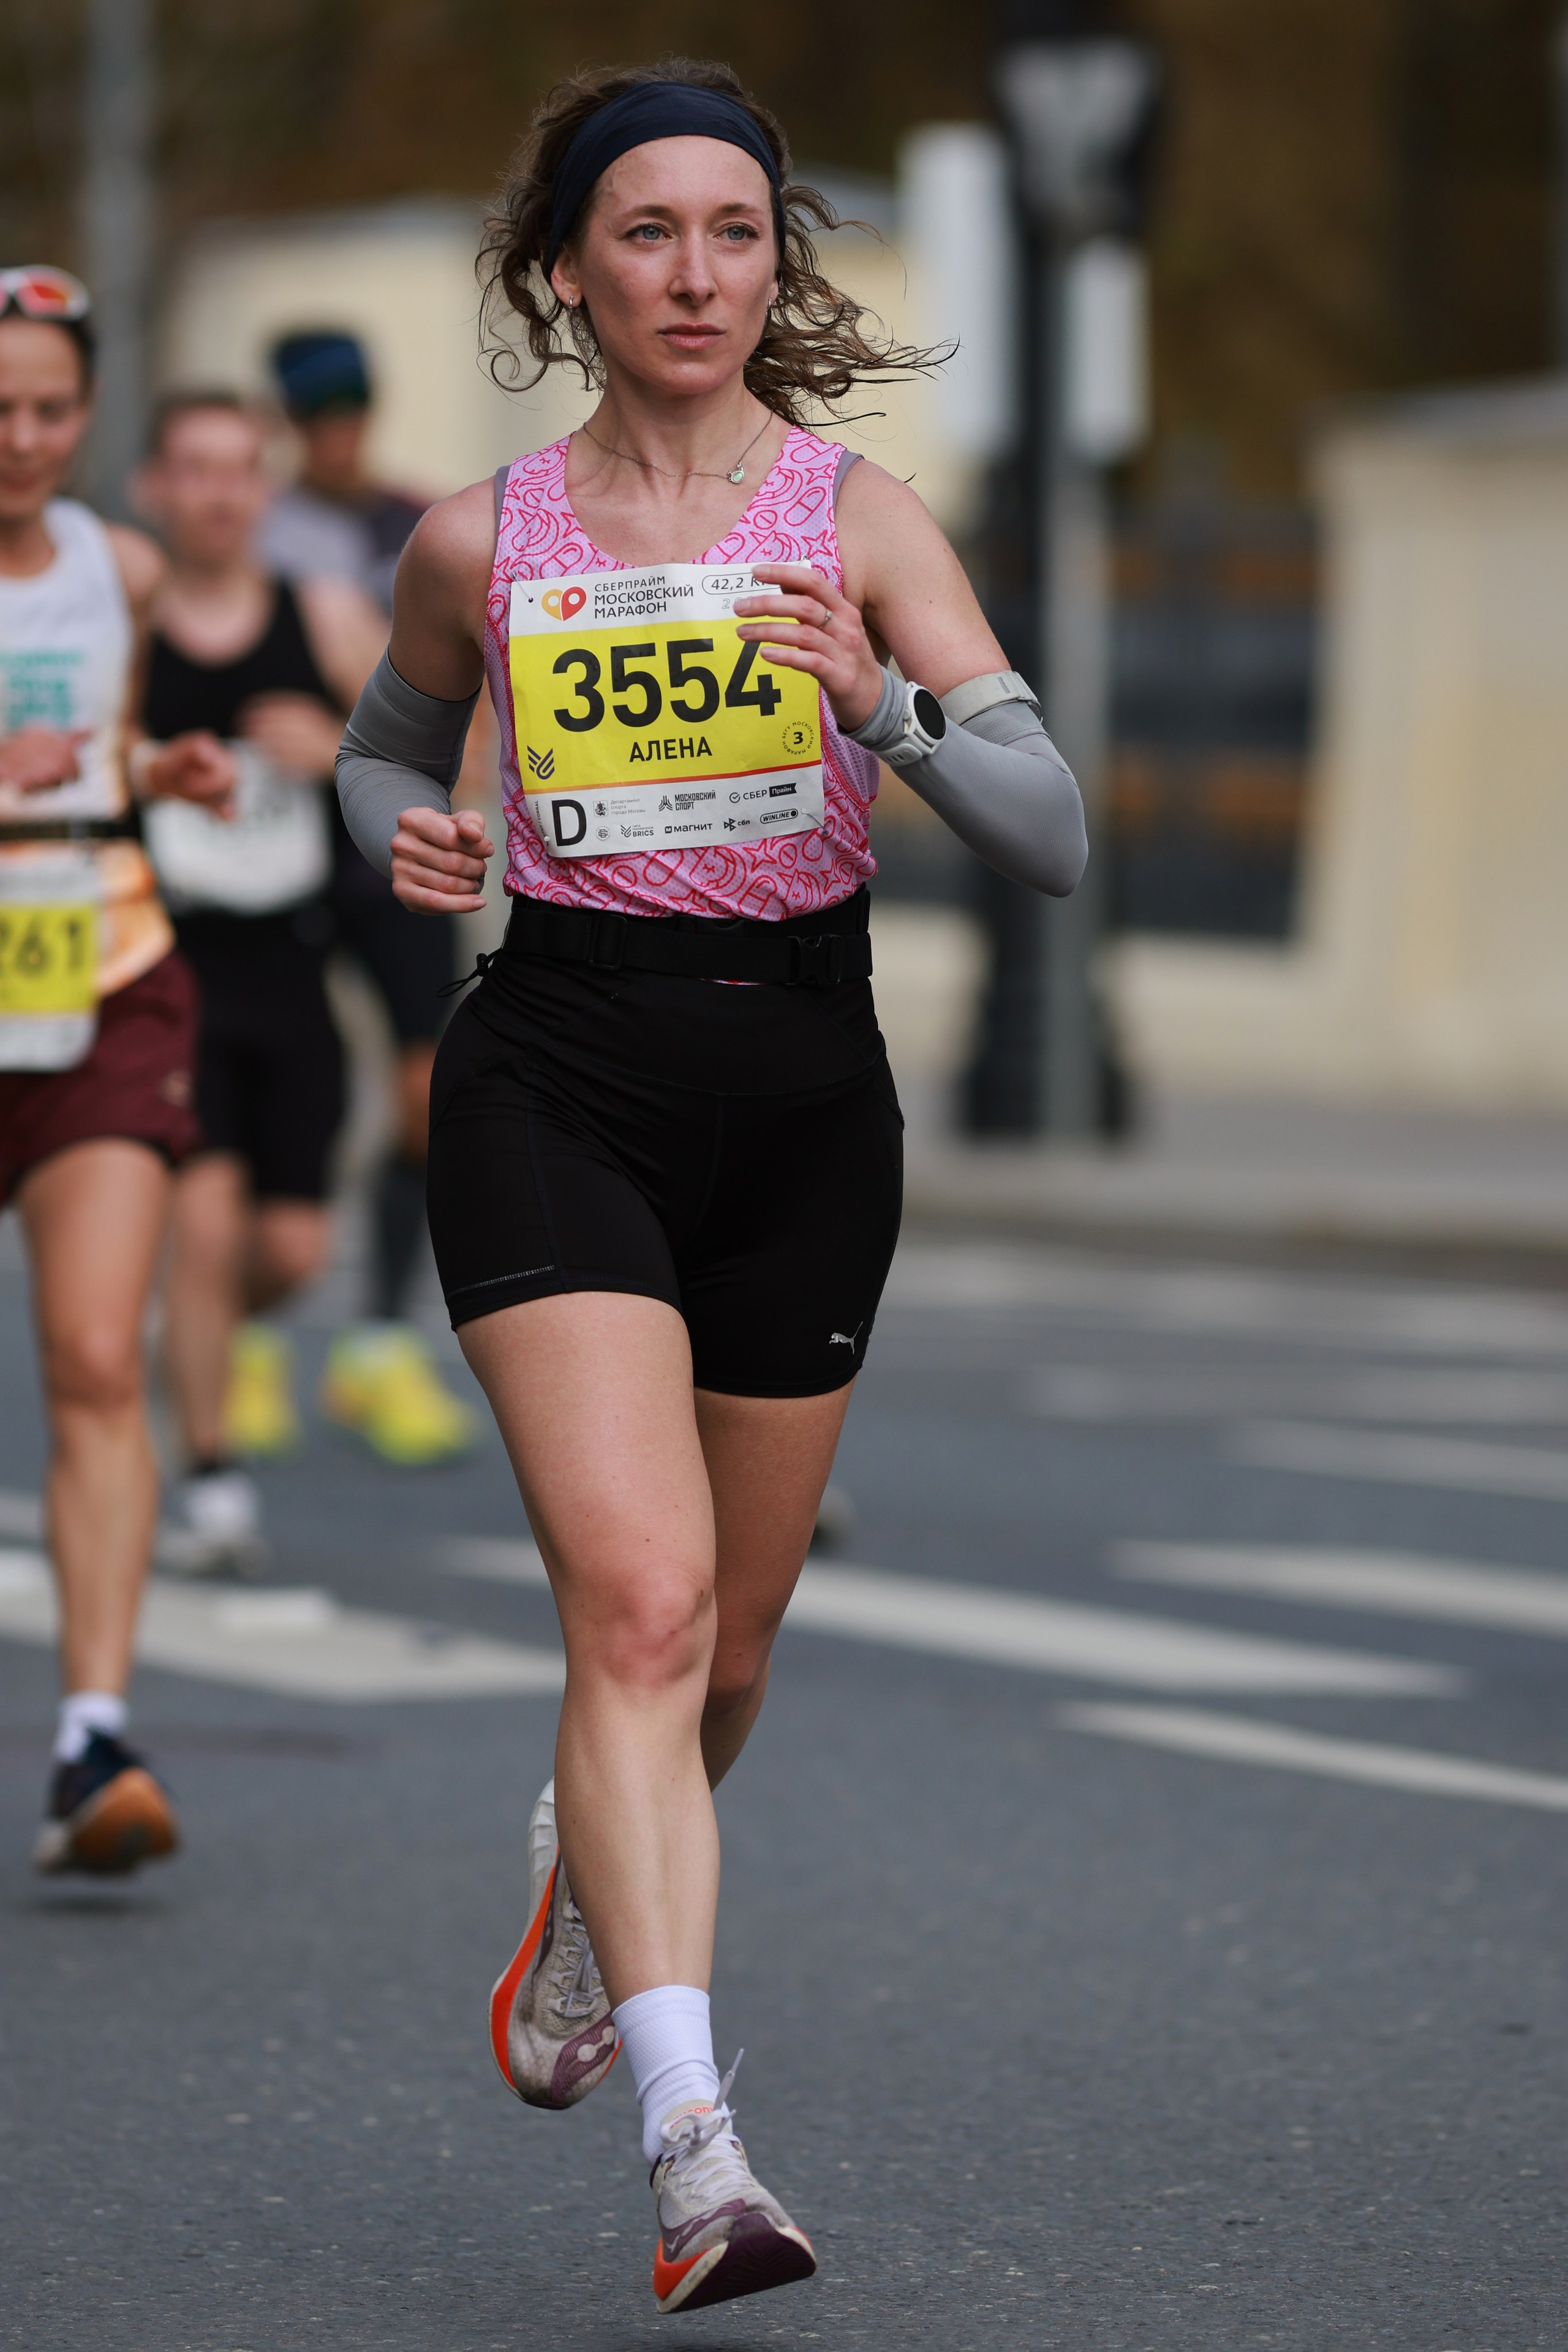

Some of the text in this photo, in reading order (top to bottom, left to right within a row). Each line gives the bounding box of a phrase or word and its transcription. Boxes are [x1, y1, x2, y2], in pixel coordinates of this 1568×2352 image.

[595, 576, 666, 592] СБЕРПРАЙМ
[711, 576, 765, 590] 42,2 К
[594, 584, 694, 606] МОСКОВСКИЙ
[594, 601, 667, 619] МАРАФОН
[552, 638, 782, 732] 3554
[793, 731, 804, 744] 3
[629, 736, 712, 763] АЛЕНА
[674, 790, 716, 802] МОСКОВСКИЙ
[743, 786, 792, 800] СБЕР Прайм
[675, 802, 694, 811] СПОРТ
[551, 799, 587, 846] D
[763, 812, 790, 822] WINLINE
